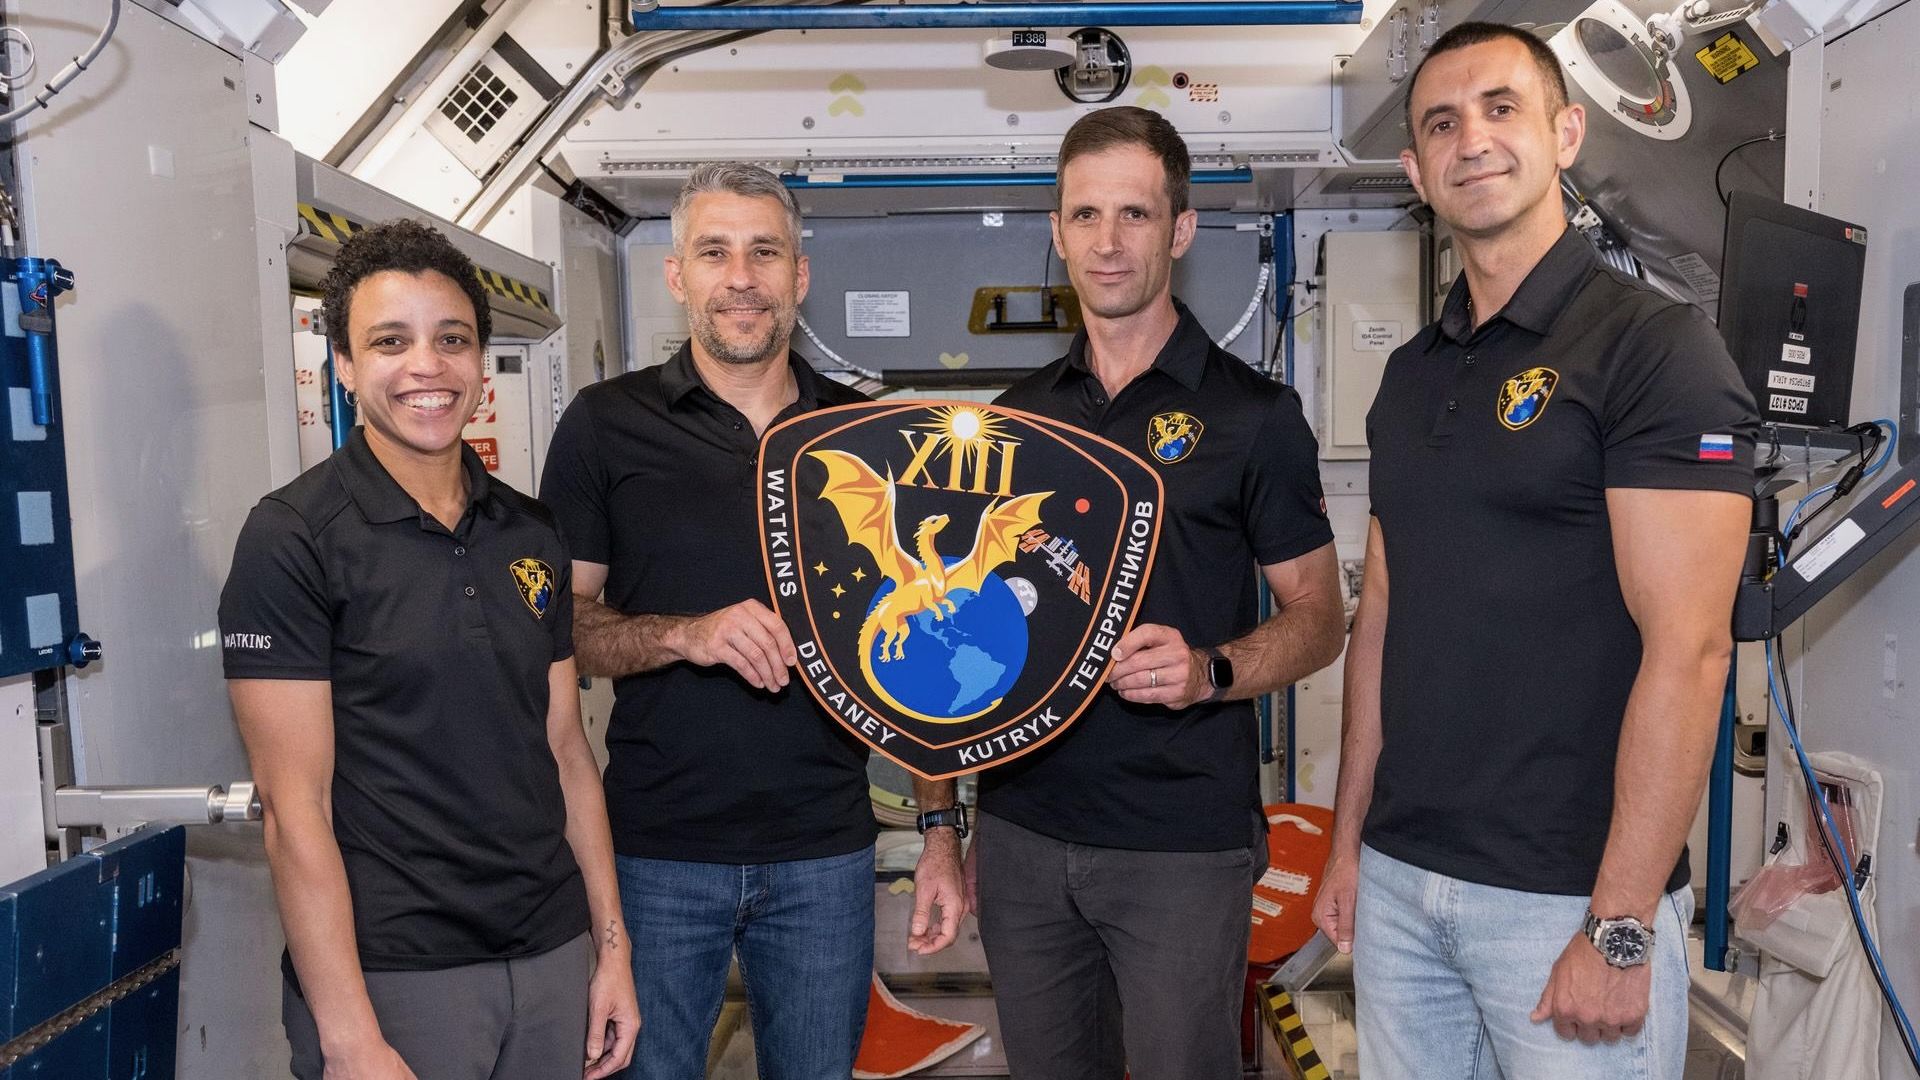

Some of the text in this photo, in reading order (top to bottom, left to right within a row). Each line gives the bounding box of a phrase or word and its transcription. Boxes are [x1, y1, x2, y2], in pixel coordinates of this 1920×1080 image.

[1013, 32, 1045, 44] FI 388
[896, 430, 1022, 498] XIII
[767, 468, 798, 597] WATKINS
[1068, 501, 1154, 691] ТЕТЕРЯТНИКОВ
[223, 633, 272, 650] WATKINS
[797, 640, 898, 745] DELANEY
[958, 706, 1062, 766] KUTRYK
